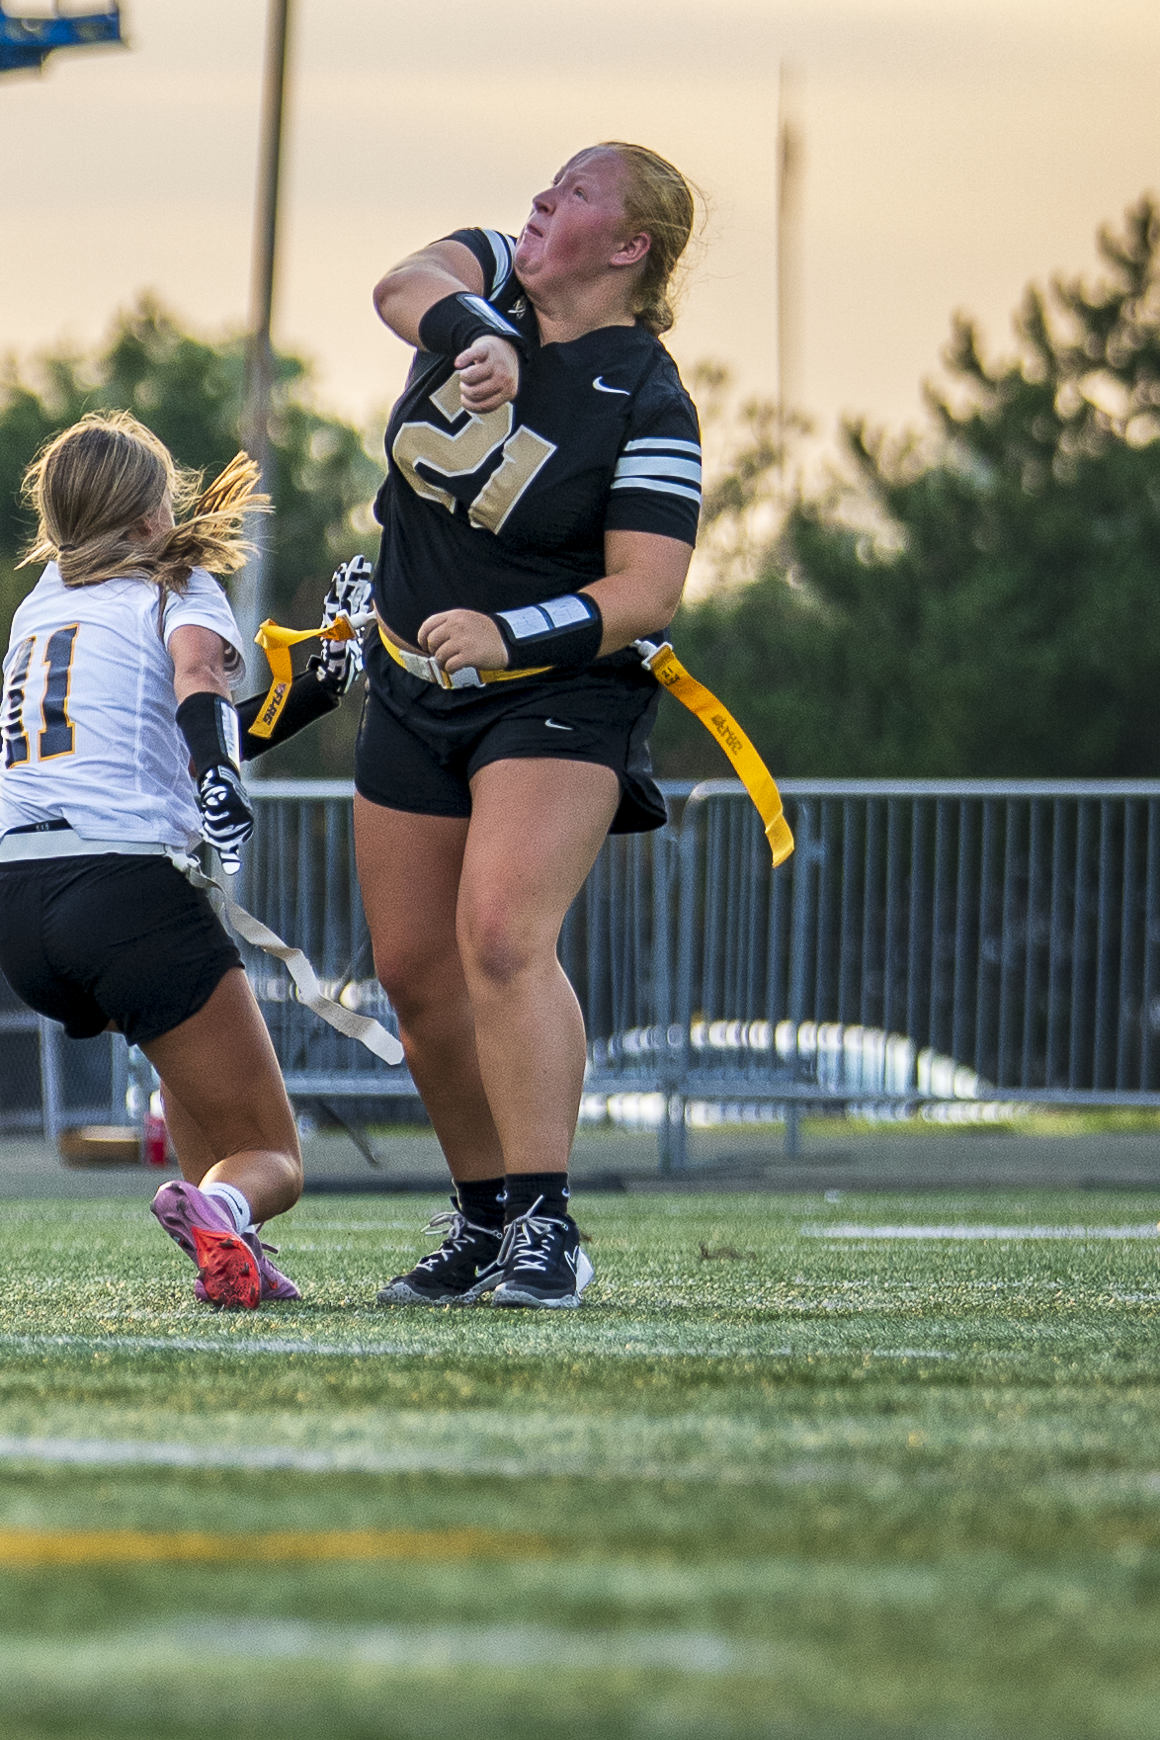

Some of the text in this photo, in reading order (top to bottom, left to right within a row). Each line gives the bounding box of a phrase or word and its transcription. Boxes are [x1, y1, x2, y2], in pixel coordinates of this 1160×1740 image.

[392, 369, 558, 535] 21
[4, 622, 80, 769] 11
[262, 688, 283, 726] FLAG
